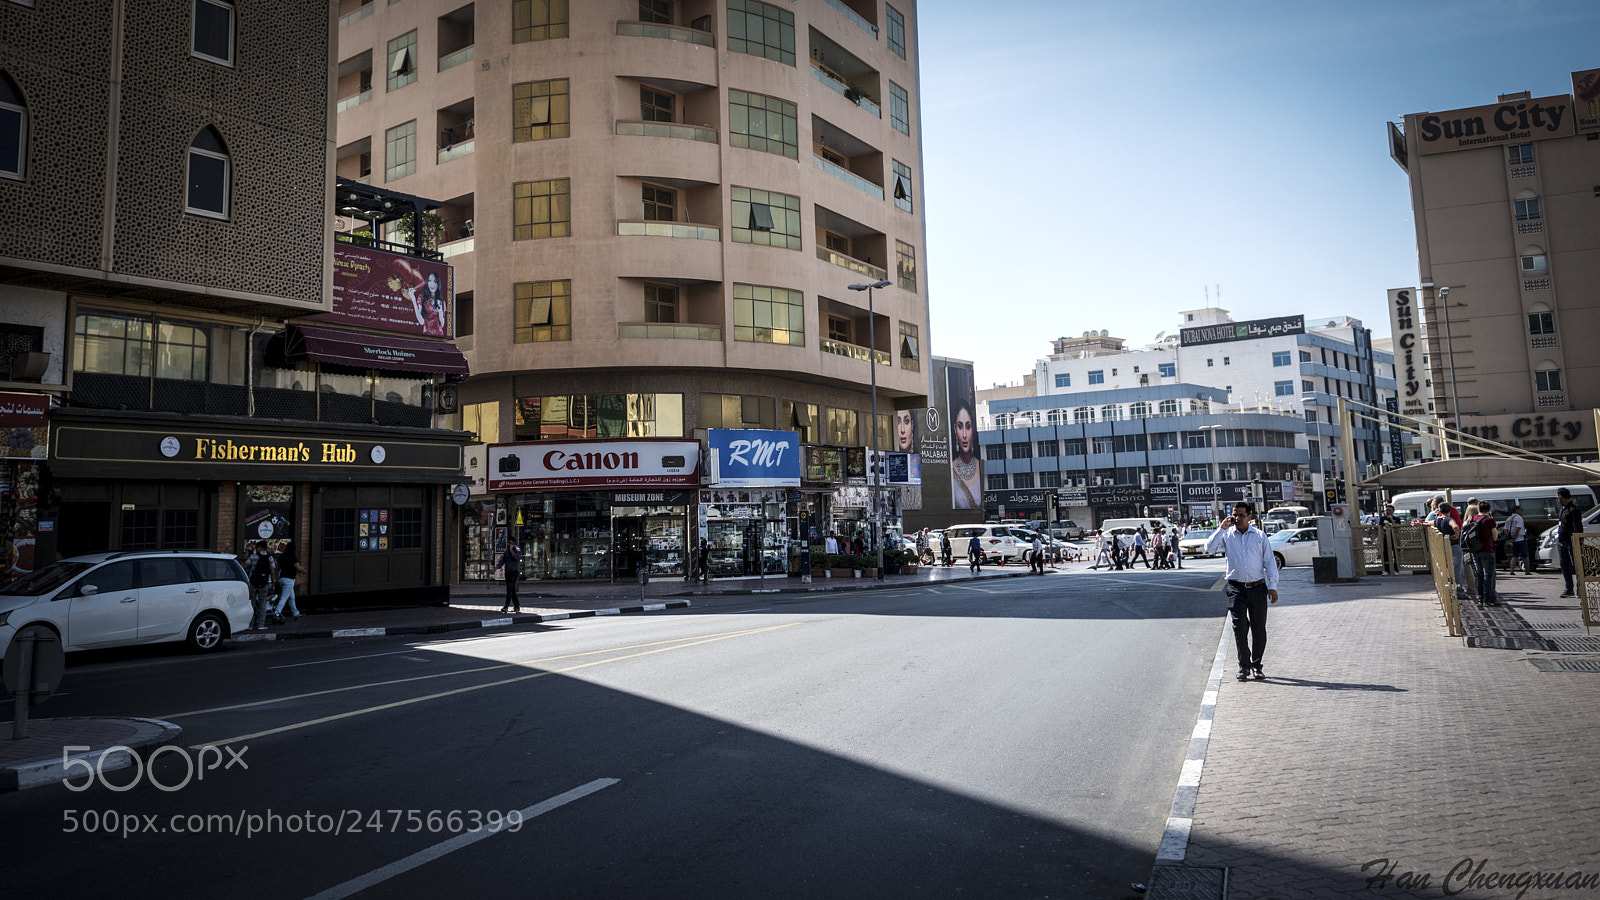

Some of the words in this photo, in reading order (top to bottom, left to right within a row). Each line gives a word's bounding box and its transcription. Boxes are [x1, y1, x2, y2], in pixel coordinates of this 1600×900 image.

[1422, 116, 1487, 142] Sun
[1494, 104, 1566, 132] City
[1458, 134, 1509, 147] International
[1510, 131, 1531, 141] Hotel
[1396, 290, 1413, 330] Sun
[1282, 319, 1302, 332] فندق
[1183, 329, 1201, 343] DUBAI
[1201, 328, 1217, 342] NOVA
[1216, 325, 1236, 340] HOTEL
[363, 347, 392, 356] Sherlock
[1399, 333, 1419, 397] City
[1405, 397, 1422, 407] INT'L
[1403, 408, 1426, 416] HOTEL
[1512, 416, 1582, 441] City
[194, 438, 310, 462] Fisherman's
[321, 442, 357, 464] Hub
[1523, 439, 1555, 448] HOTEL
[543, 450, 639, 471] Canon
[728, 438, 790, 467] RMT
[921, 450, 948, 458] MALABAR
[615, 493, 646, 502] MUSEUM
[646, 493, 665, 502] ZONE
[1091, 495, 1146, 503] archana
